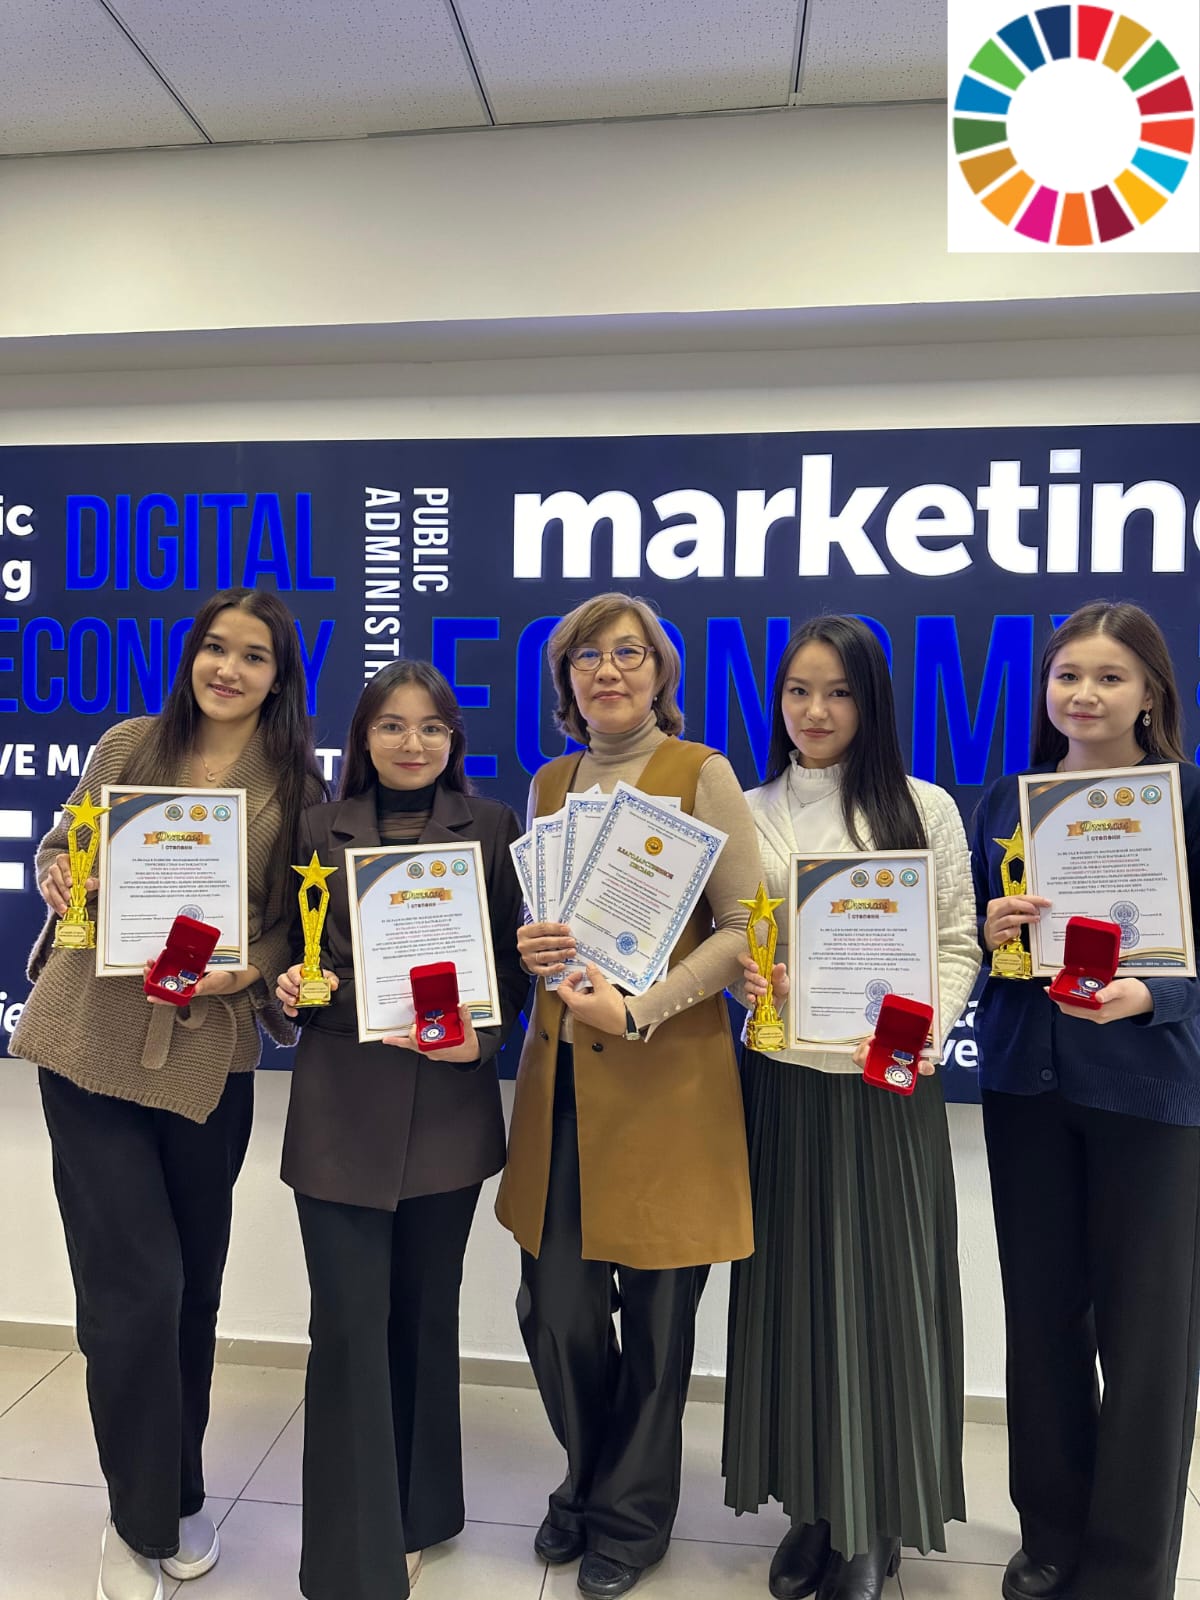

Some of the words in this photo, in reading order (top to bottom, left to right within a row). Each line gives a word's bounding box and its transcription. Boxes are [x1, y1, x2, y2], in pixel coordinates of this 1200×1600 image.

[65, 492, 336, 591] DIGITAL
[413, 488, 449, 592] PUBLIC
[513, 449, 1200, 579] marketin
[364, 487, 400, 688] ADMINIST
[0, 616, 336, 716] CONY
[431, 614, 1075, 787] ECNM
